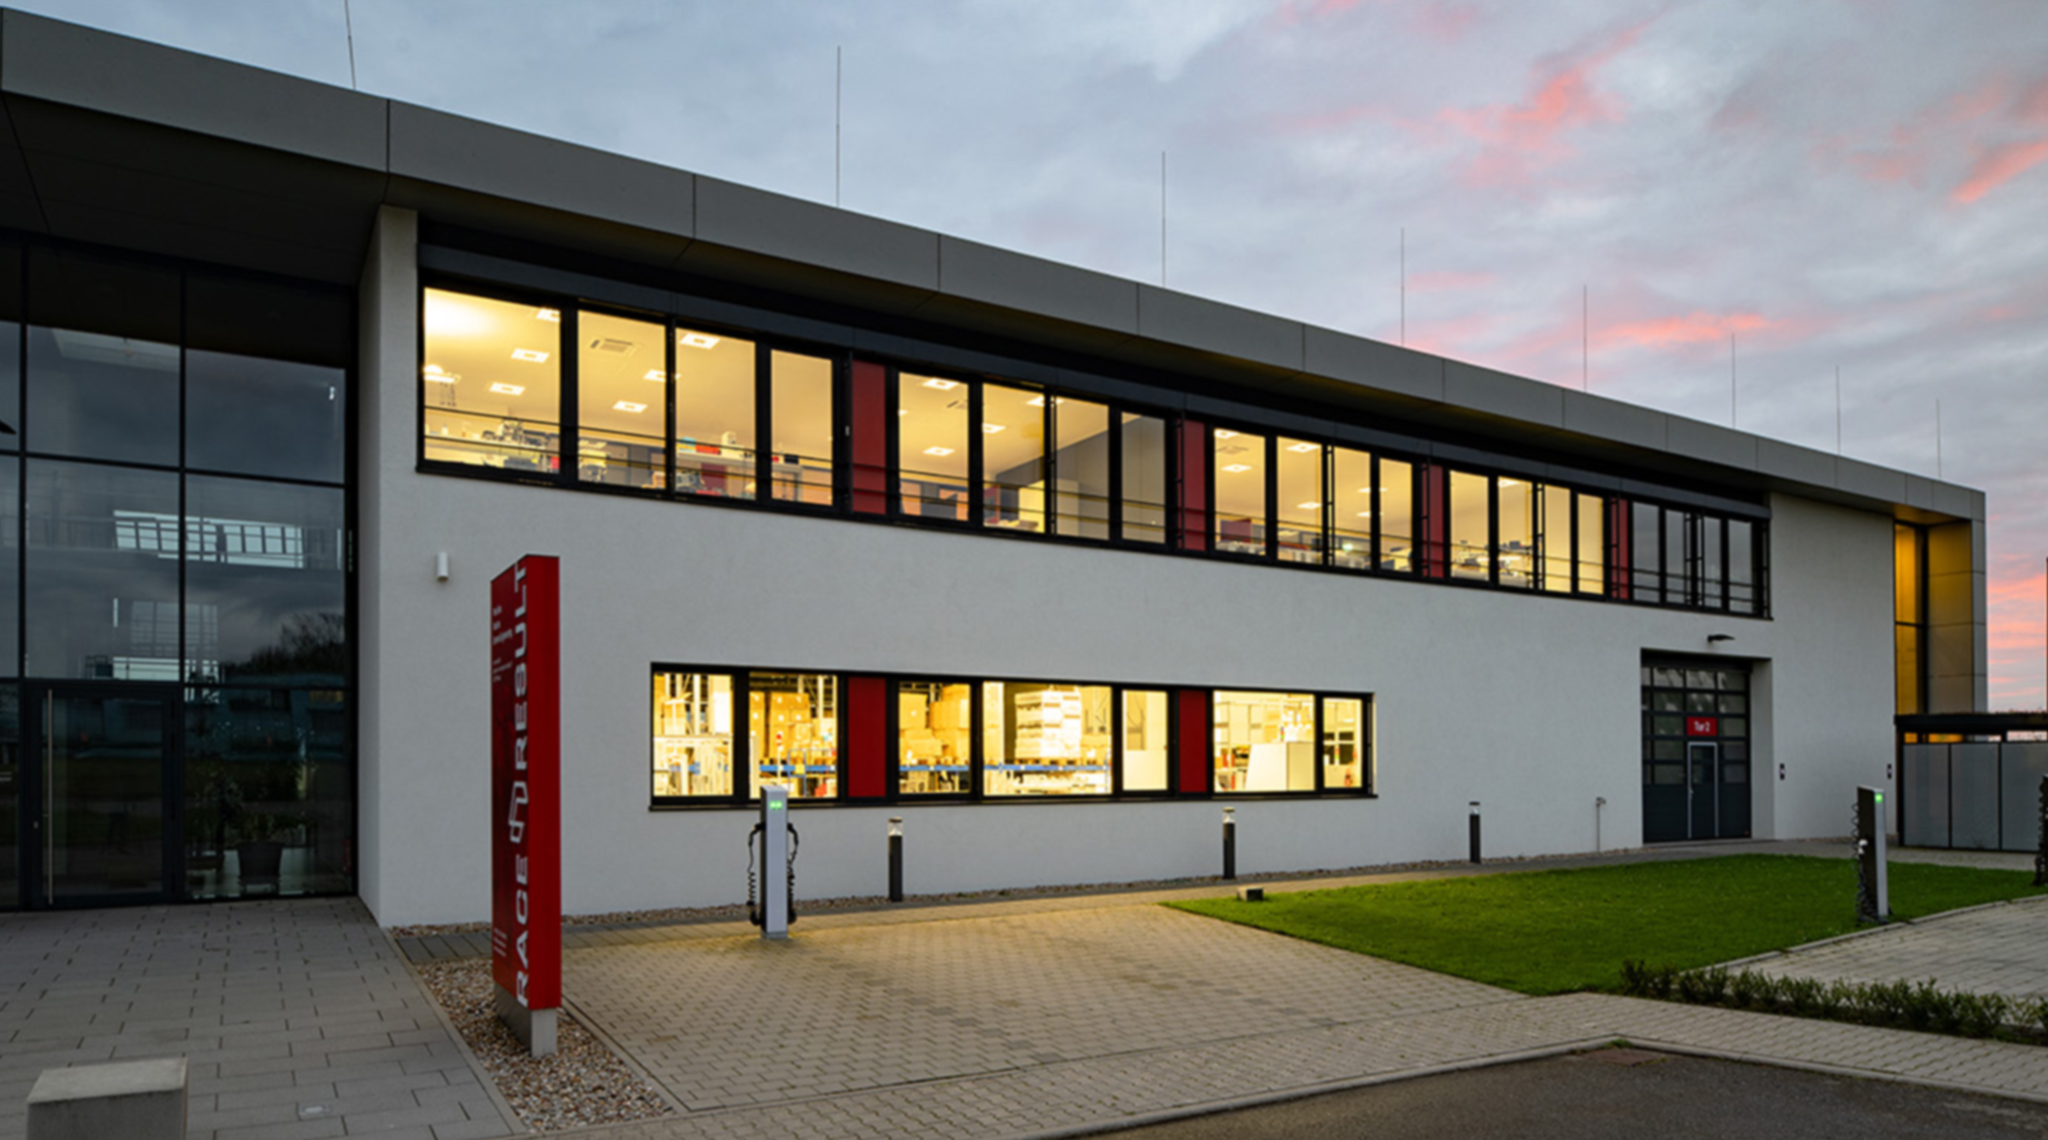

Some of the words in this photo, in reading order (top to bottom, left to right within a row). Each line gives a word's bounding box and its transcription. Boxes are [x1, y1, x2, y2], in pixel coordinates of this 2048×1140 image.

[513, 562, 528, 771] RESULT
[1694, 720, 1705, 732] Tor
[515, 853, 529, 1008] RACE
